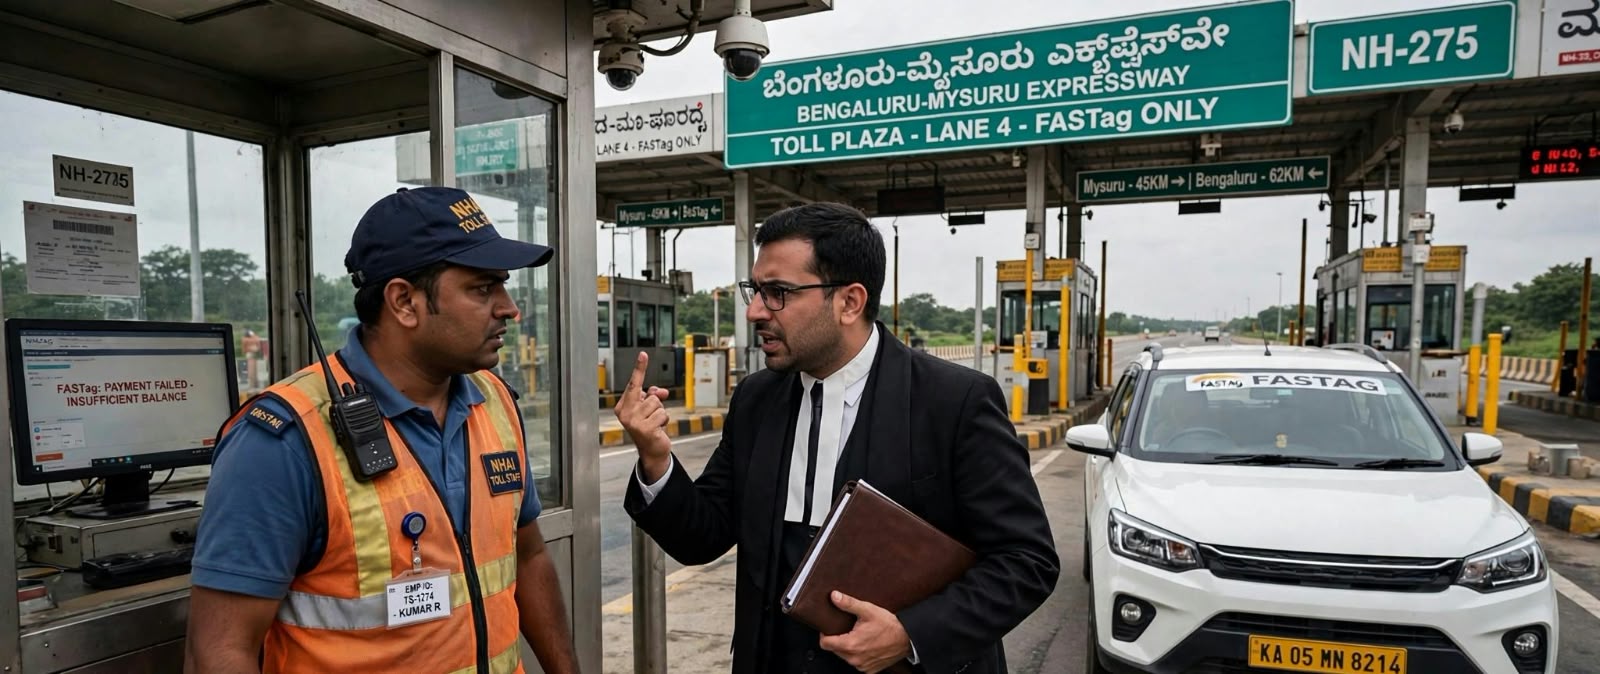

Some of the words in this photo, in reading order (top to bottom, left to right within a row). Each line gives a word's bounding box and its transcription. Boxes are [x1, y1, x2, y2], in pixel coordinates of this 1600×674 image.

[1341, 24, 1479, 71] NH-275
[797, 83, 1019, 123] BENGALURU-MYSURU
[1026, 65, 1190, 100] EXPRESSWAY
[771, 133, 825, 156] TOLL
[831, 126, 904, 151] PLAZA
[925, 118, 990, 143] LANE
[996, 116, 1012, 137] 4
[1035, 108, 1132, 132] FASTag
[1141, 97, 1219, 124] ONLY
[597, 143, 621, 155] LANE
[638, 139, 673, 152] FASTag
[676, 135, 702, 148] ONLY
[1083, 178, 1126, 197] Mysuru
[1136, 174, 1169, 190] 45KM
[1195, 170, 1258, 190] Bengaluru
[1269, 166, 1305, 183] 62KM
[57, 383, 101, 394] FASTag:
[104, 381, 151, 392] PAYMENT
[155, 380, 188, 390] FAILED
[1252, 375, 1379, 391] FASTAG
[67, 393, 139, 407] INSUFFICIENT
[142, 392, 187, 403] BALANCE
[490, 457, 516, 472] NHAI
[490, 475, 506, 486] TOLL
[405, 583, 421, 594] EMP
[399, 603, 433, 618] KUMAR
[434, 602, 441, 611] R
[1260, 643, 1283, 664] KA
[1290, 646, 1313, 667] 05
[1320, 649, 1344, 669] MN
[1351, 652, 1401, 674] 8214
